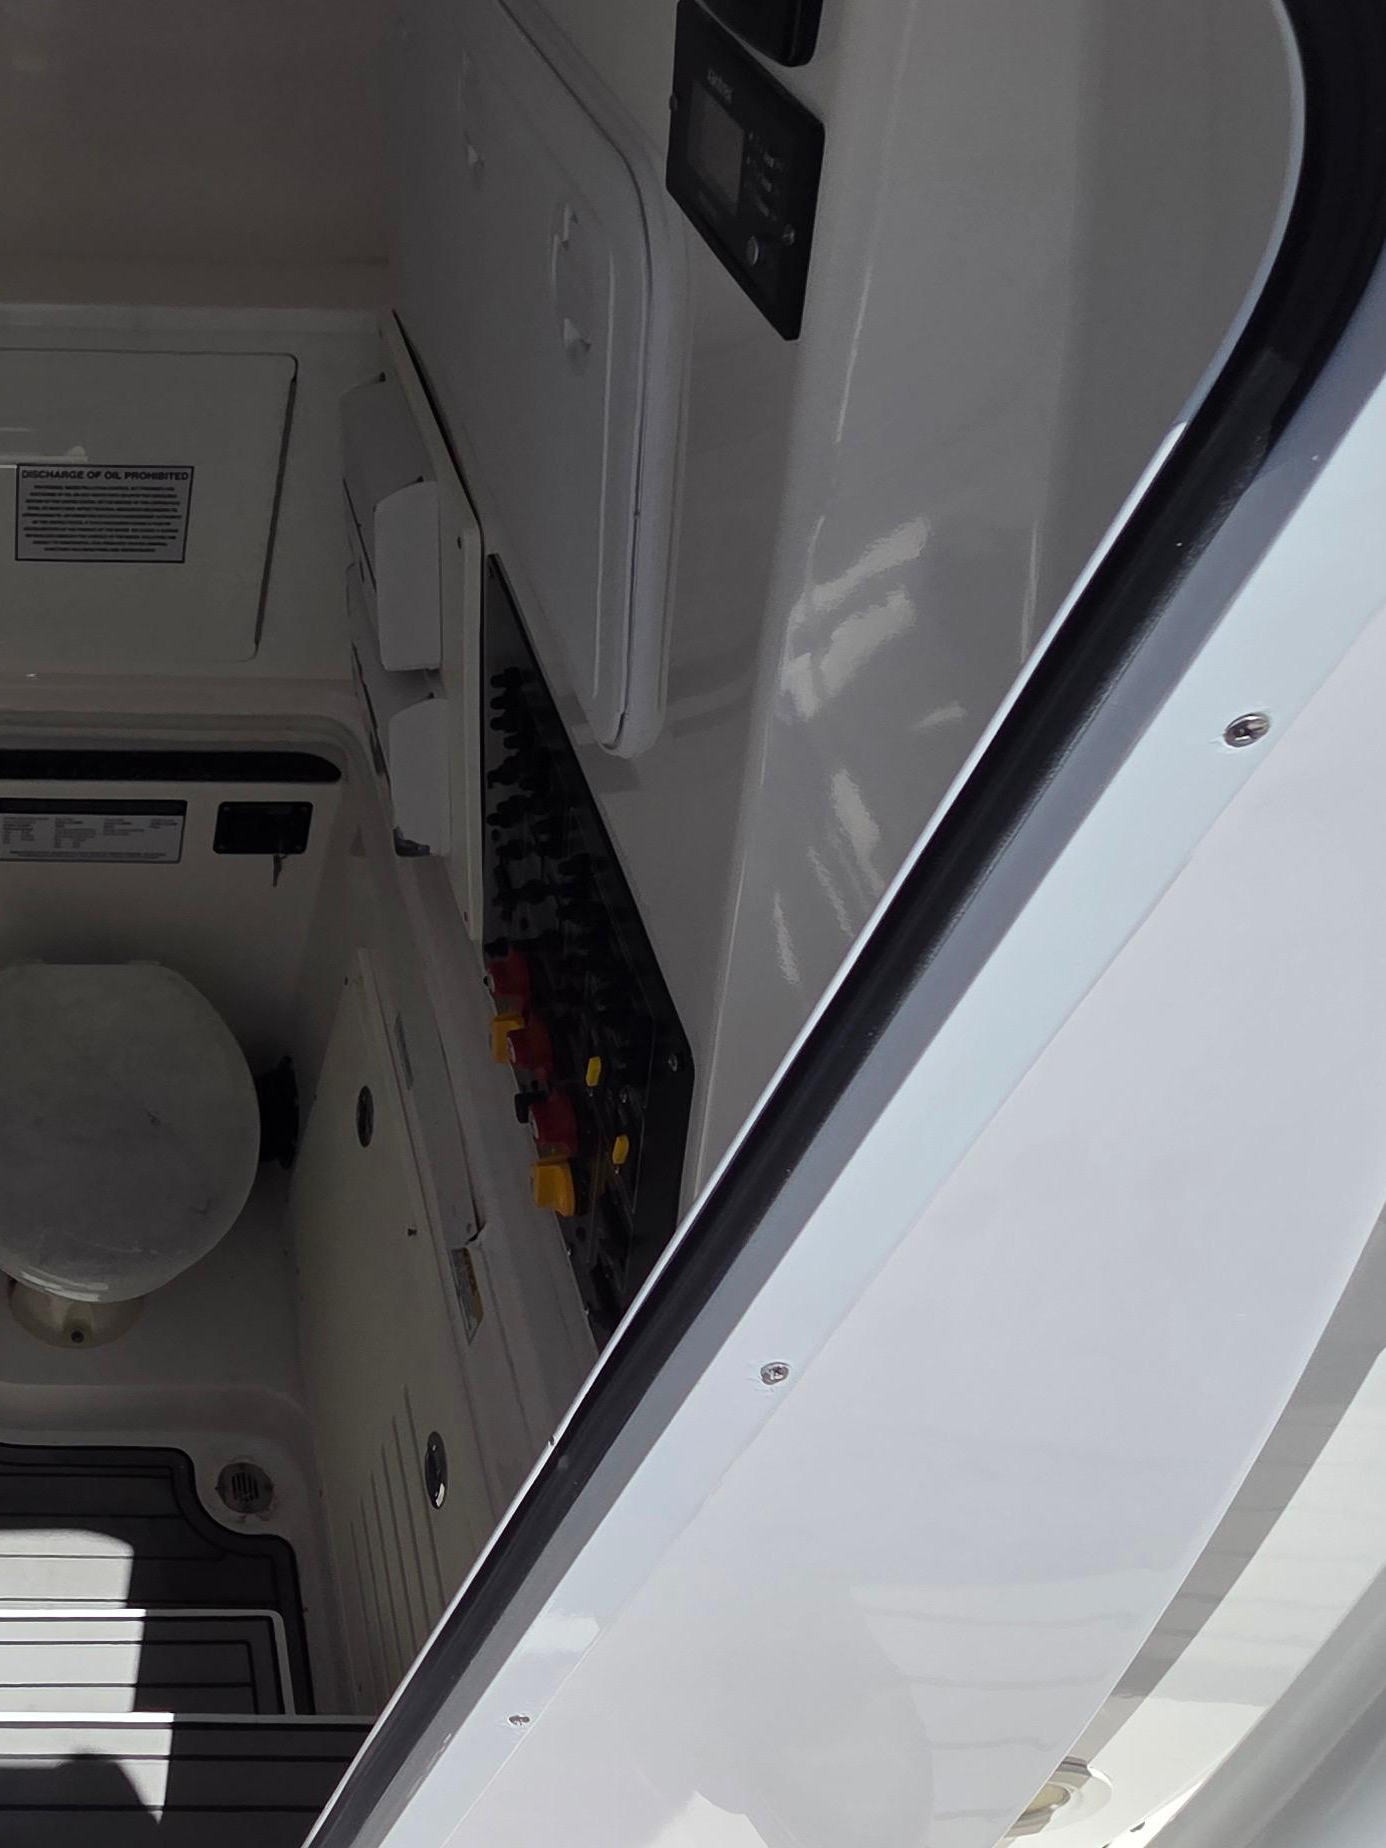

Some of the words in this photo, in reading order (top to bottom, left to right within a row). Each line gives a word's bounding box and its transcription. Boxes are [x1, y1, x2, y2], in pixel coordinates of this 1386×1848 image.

[22, 469, 84, 479] DISCHARGE
[87, 470, 102, 479] OF
[104, 470, 122, 480] OIL
[124, 470, 190, 480] PROHIBITED
